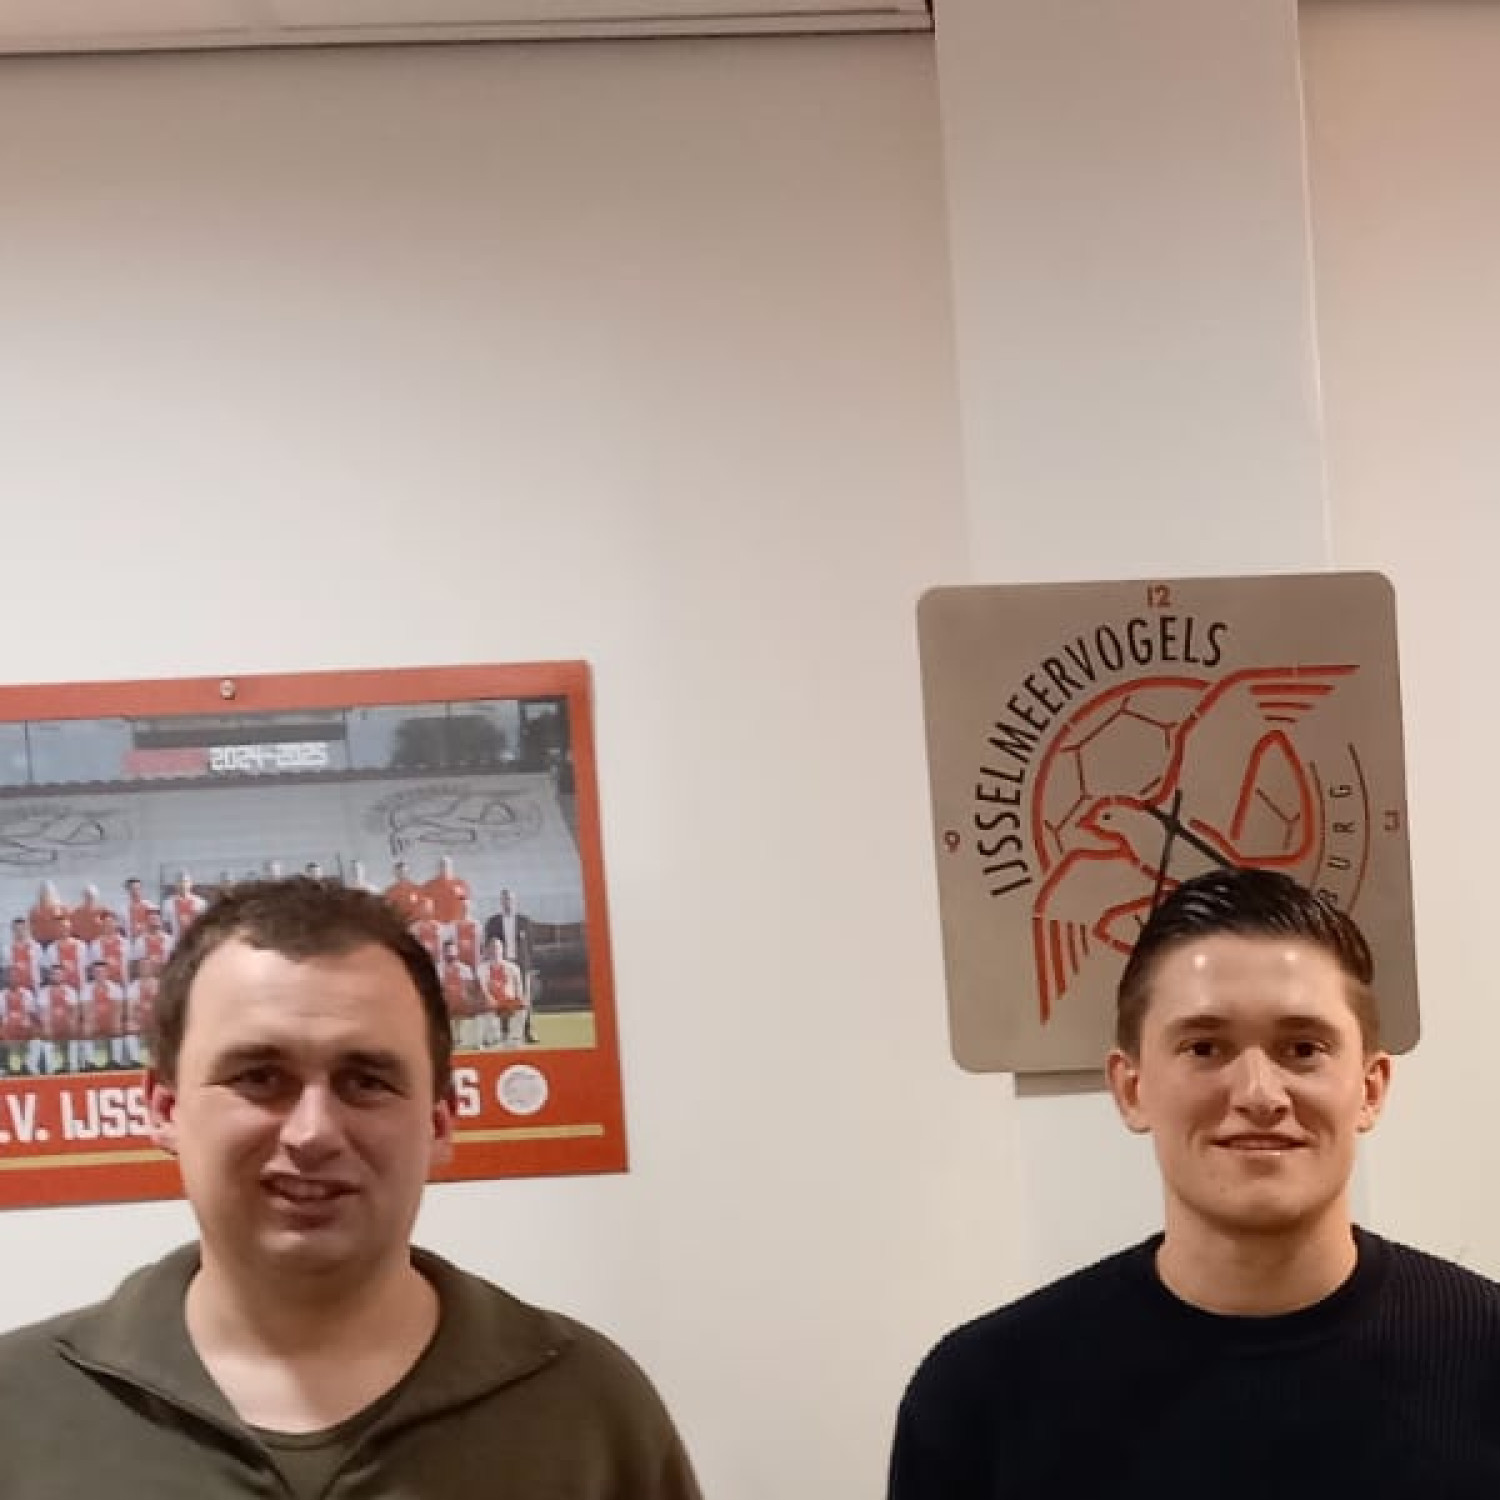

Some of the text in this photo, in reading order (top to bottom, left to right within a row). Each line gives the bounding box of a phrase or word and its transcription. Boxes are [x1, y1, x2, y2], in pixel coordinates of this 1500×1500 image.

[1147, 584, 1171, 608] 12
[974, 615, 1228, 897] IJSSELMEERVOGELS
[944, 829, 961, 854] 9
[59, 1086, 152, 1141] IJSS
